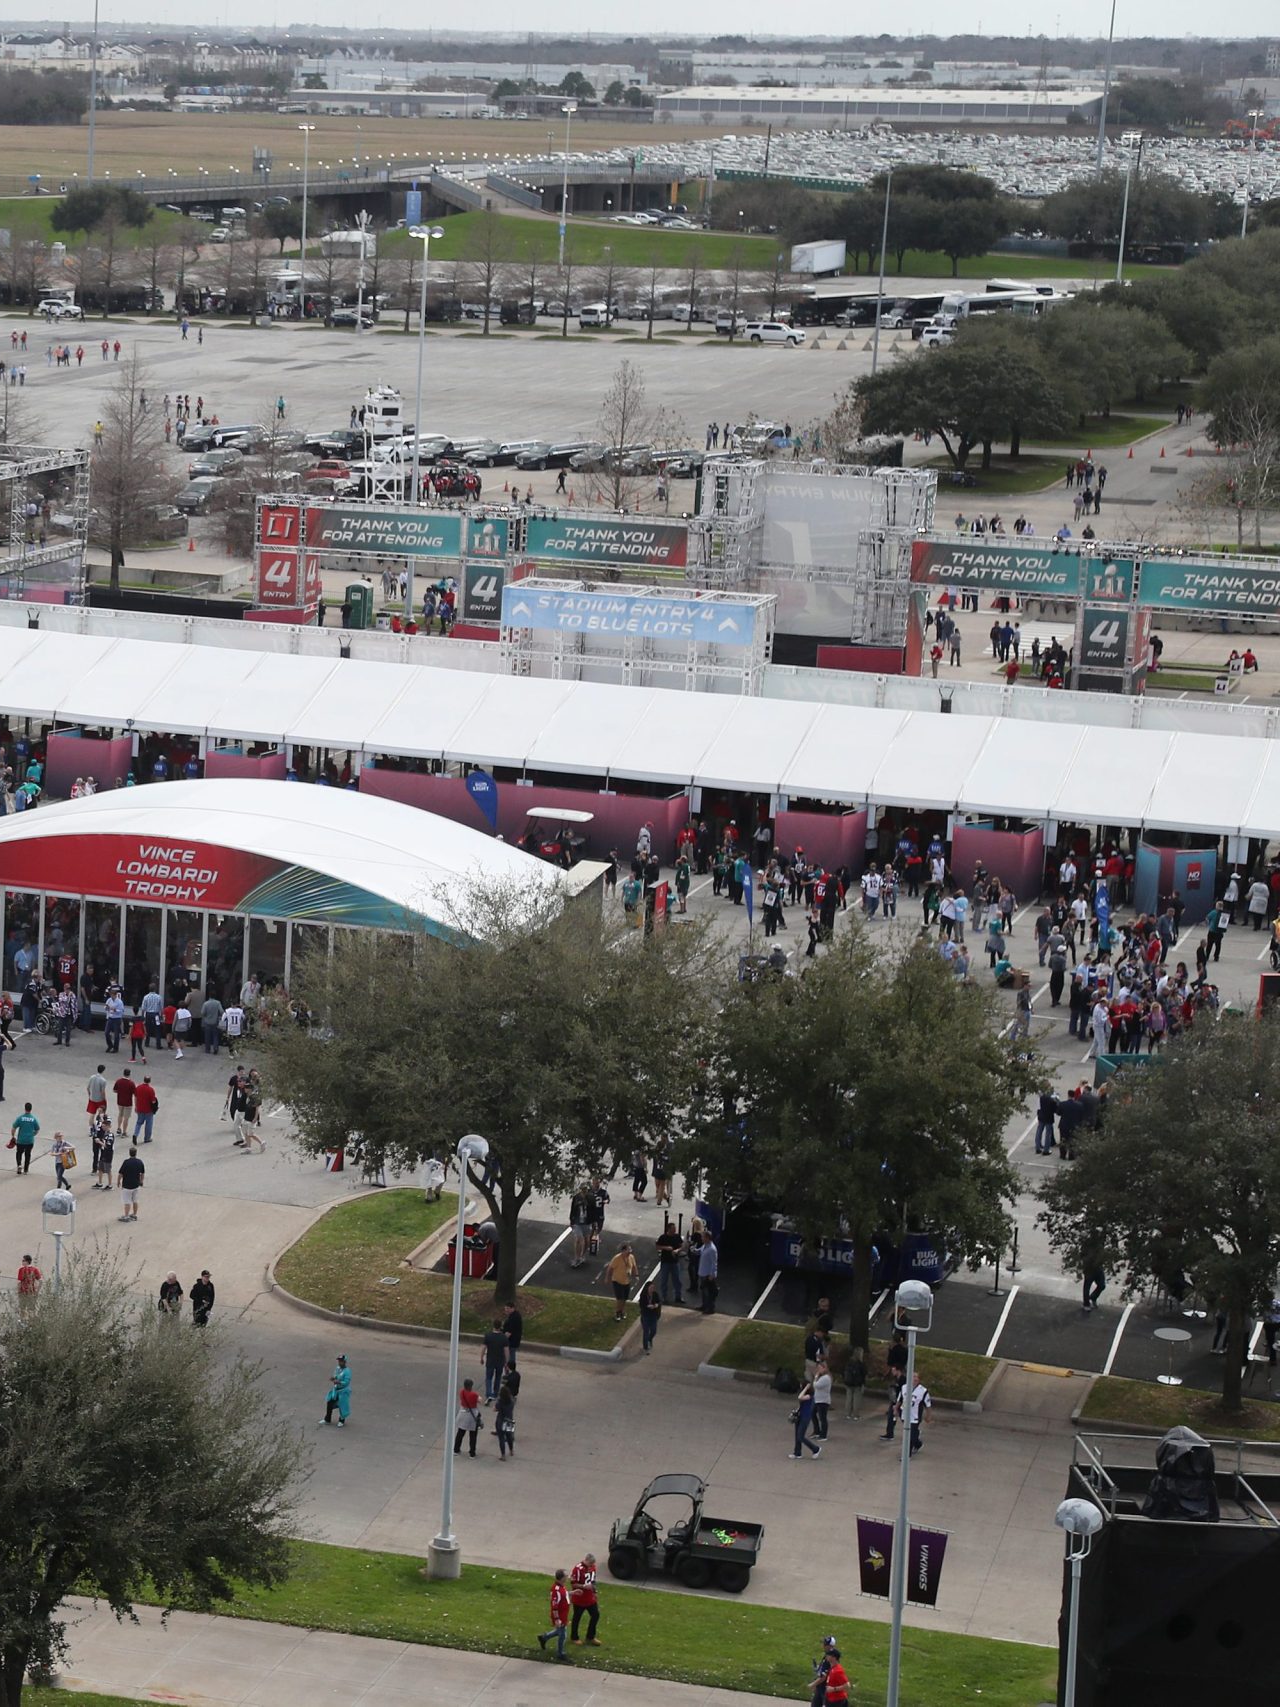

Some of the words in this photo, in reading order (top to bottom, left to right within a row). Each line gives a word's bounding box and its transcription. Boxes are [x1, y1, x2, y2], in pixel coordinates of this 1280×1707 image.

[266, 516, 294, 538] LI
[341, 518, 394, 531] THANK
[397, 520, 429, 534] YOU
[322, 530, 357, 542] FOR
[356, 532, 444, 548] ATTENDING
[474, 533, 501, 550] LI
[564, 528, 620, 541] THANK
[622, 531, 655, 543] YOU
[544, 538, 579, 550] FOR
[579, 541, 669, 558] ATTENDING
[951, 552, 1010, 568] THANK
[1014, 556, 1051, 570] YOU
[265, 560, 292, 588] 4
[306, 558, 317, 586] 4
[928, 564, 970, 577] FOR
[965, 567, 1067, 585] ATTENDING
[472, 576, 497, 602] 4
[1093, 576, 1125, 594] LI
[1184, 574, 1248, 589] THANK
[263, 590, 292, 599] ENTRY
[1160, 586, 1197, 598] FOR
[1200, 590, 1280, 606] ATTENDI
[470, 604, 496, 612] ENTRY
[536, 596, 626, 614] STADIUM
[630, 604, 700, 620] ENTRY
[700, 608, 715, 622] 4
[558, 613, 582, 628] TO
[586, 616, 638, 632] BLUE
[642, 620, 694, 635] LOTS
[1089, 620, 1120, 649] 4
[1086, 650, 1118, 660] ENTRY
[139, 844, 196, 864] VINCE
[116, 860, 218, 884] LOMBARDI
[124, 880, 207, 901] TROPHY
[60, 962, 70, 974] 12
[232, 1016, 238, 1024] 11
[827, 1248, 854, 1264] LIG
[912, 1257, 939, 1267] LIGHT
[916, 1250, 937, 1258] BUD
[919, 1544, 929, 1591] VIKINGS
